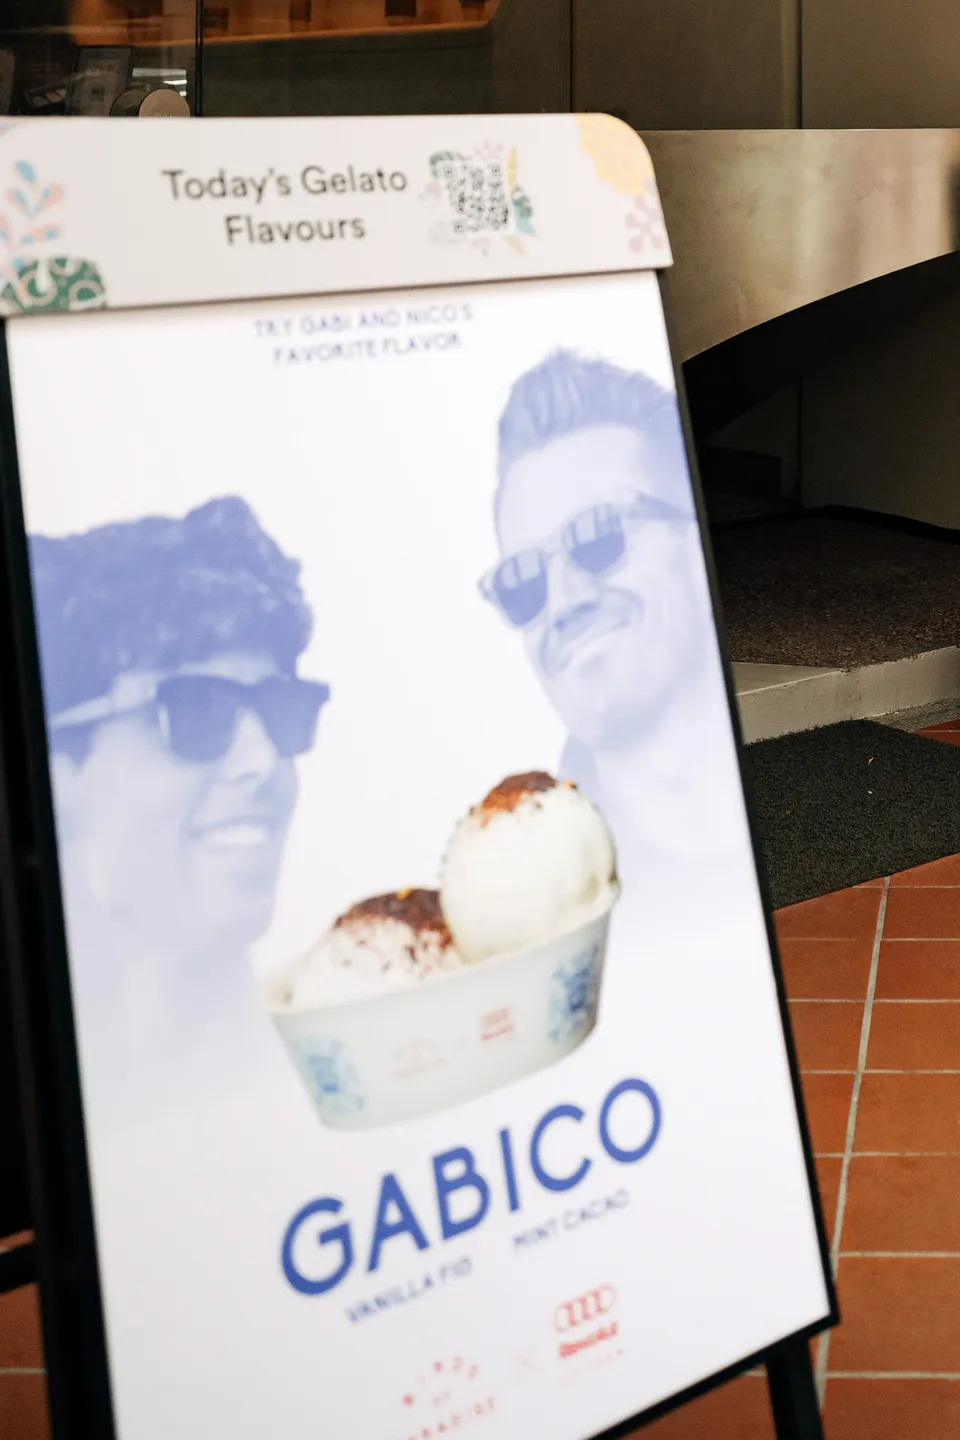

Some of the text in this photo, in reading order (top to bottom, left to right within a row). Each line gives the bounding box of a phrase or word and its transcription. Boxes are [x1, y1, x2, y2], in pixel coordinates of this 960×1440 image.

[161, 165, 408, 205] Today's Gelato
[224, 211, 366, 246] Flavours
[253, 318, 294, 338] TRY
[358, 310, 401, 330] AND
[272, 331, 462, 366] FAVORITE FLAVOR
[279, 1077, 663, 1297] GABICO
[512, 1187, 632, 1252] MINT CACAO
[345, 1272, 437, 1324] VANILLA
